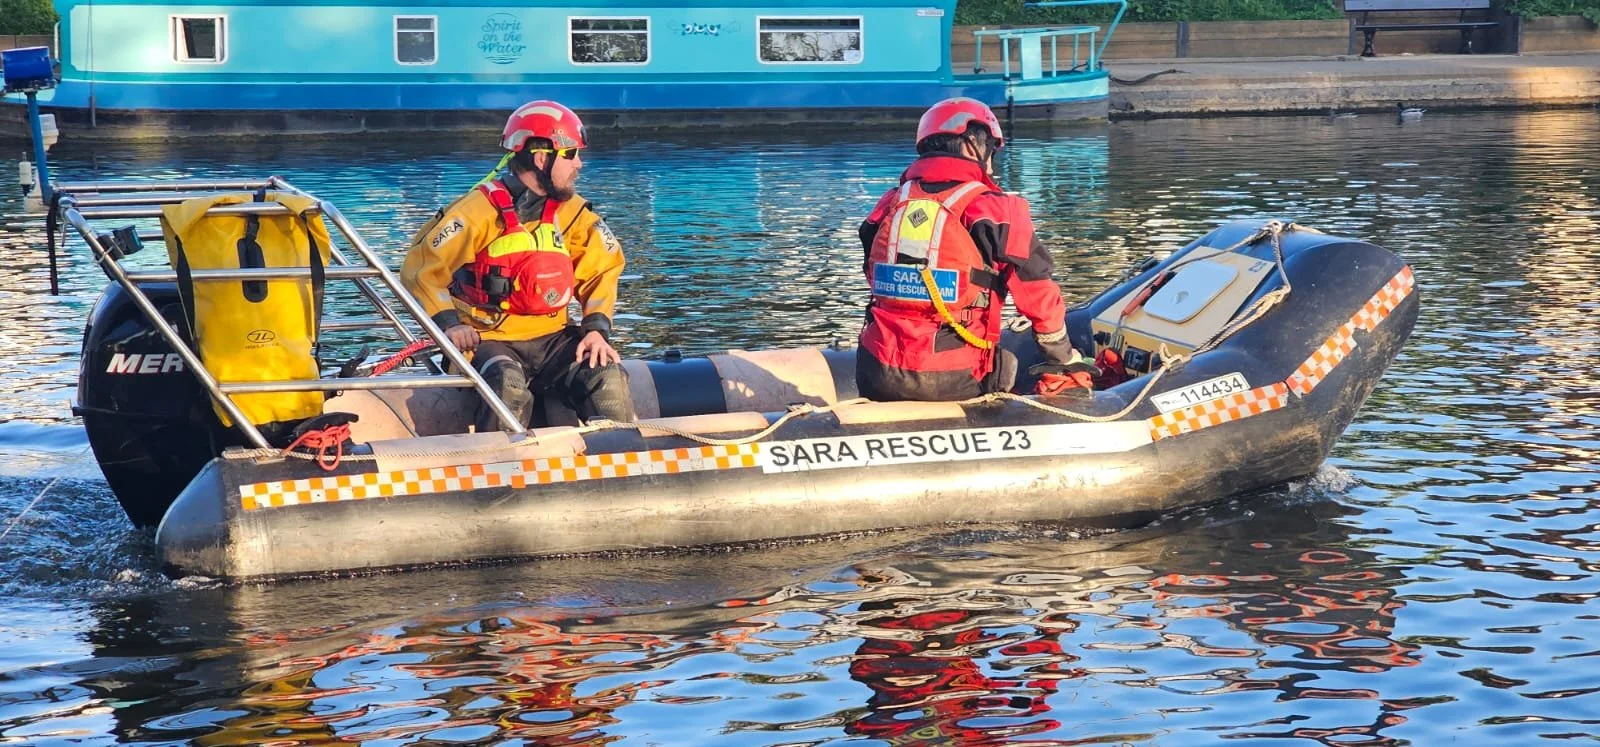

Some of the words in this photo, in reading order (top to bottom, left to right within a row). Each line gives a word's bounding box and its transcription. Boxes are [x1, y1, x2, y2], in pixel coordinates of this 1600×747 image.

[481, 18, 521, 33] Spirit
[477, 41, 527, 53] Water
[483, 33, 497, 42] on
[504, 31, 522, 42] the
[432, 220, 464, 248] SARA
[1180, 376, 1243, 403] 114434
[769, 441, 858, 467] SARA
[865, 432, 992, 460] RESCUE
[998, 429, 1032, 451] 23
